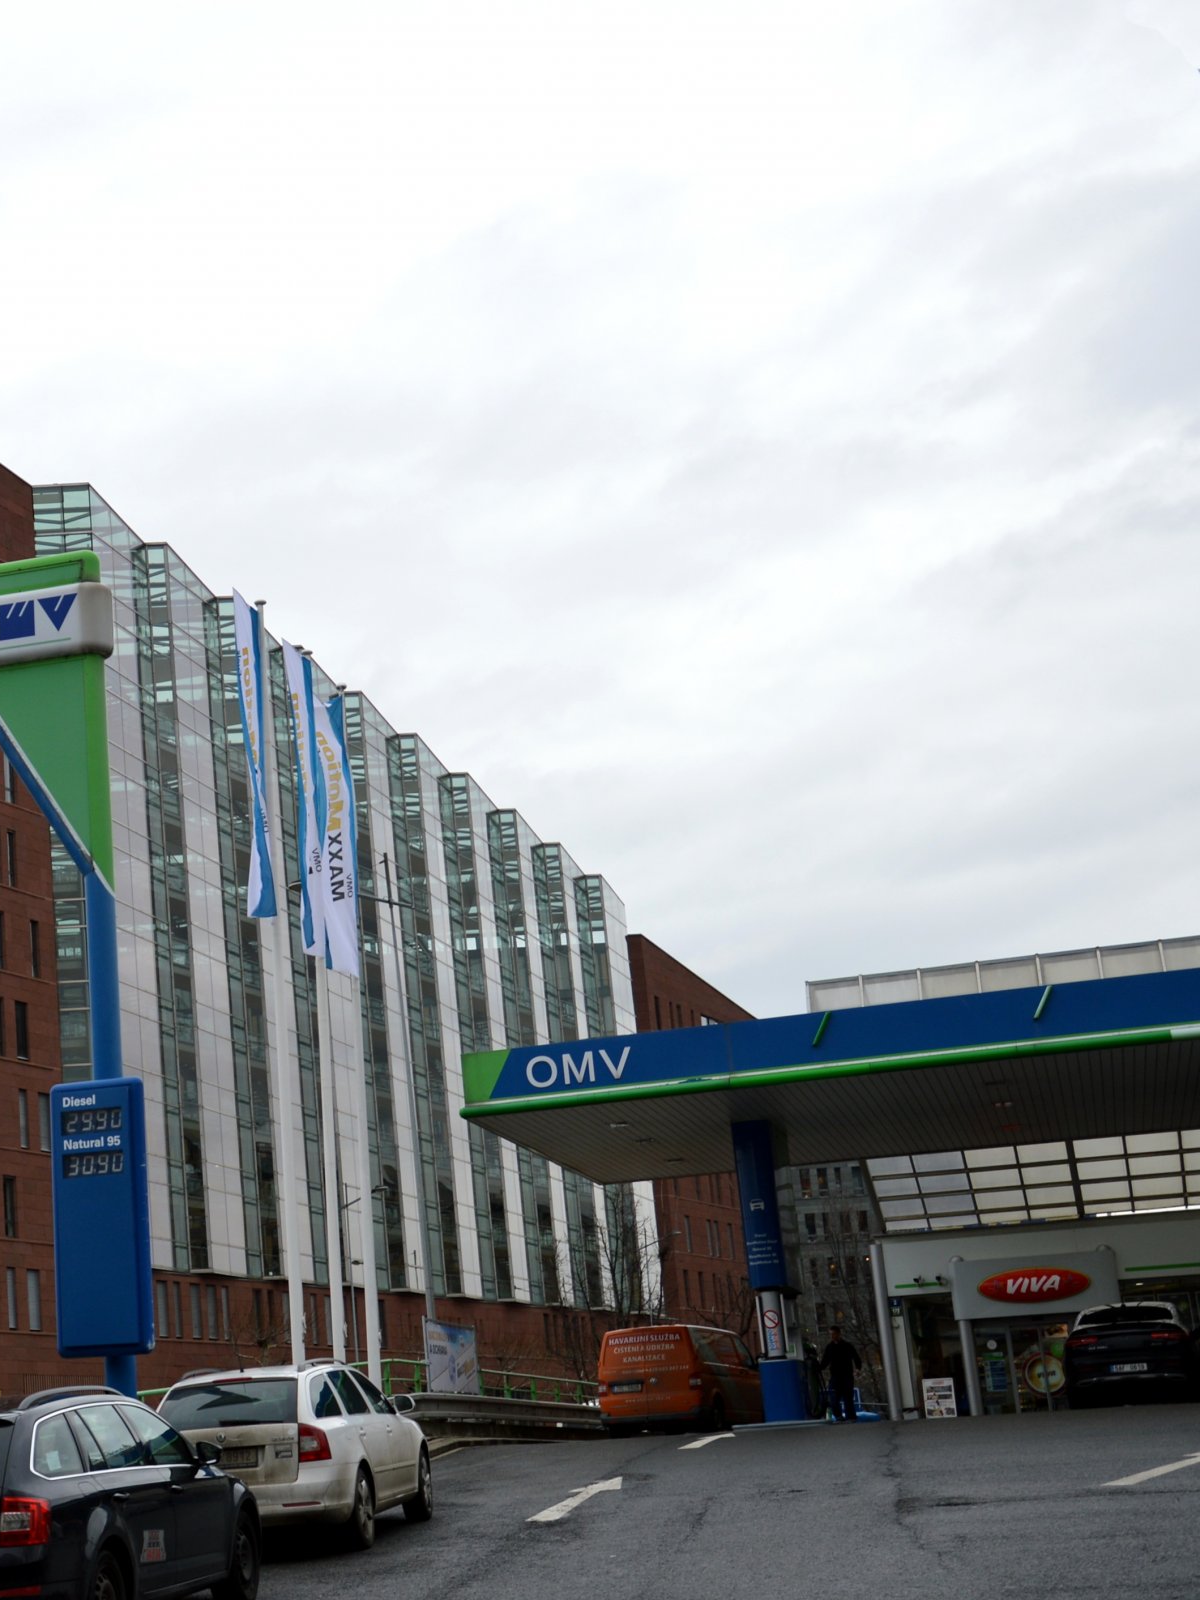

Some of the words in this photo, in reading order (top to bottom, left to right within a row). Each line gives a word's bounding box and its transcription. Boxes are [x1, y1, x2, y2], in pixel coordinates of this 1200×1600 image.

[526, 1046, 631, 1088] OMV
[62, 1094, 96, 1108] Diesel
[63, 1136, 104, 1150] Natural
[107, 1135, 121, 1147] 95
[1006, 1274, 1061, 1295] VIVA
